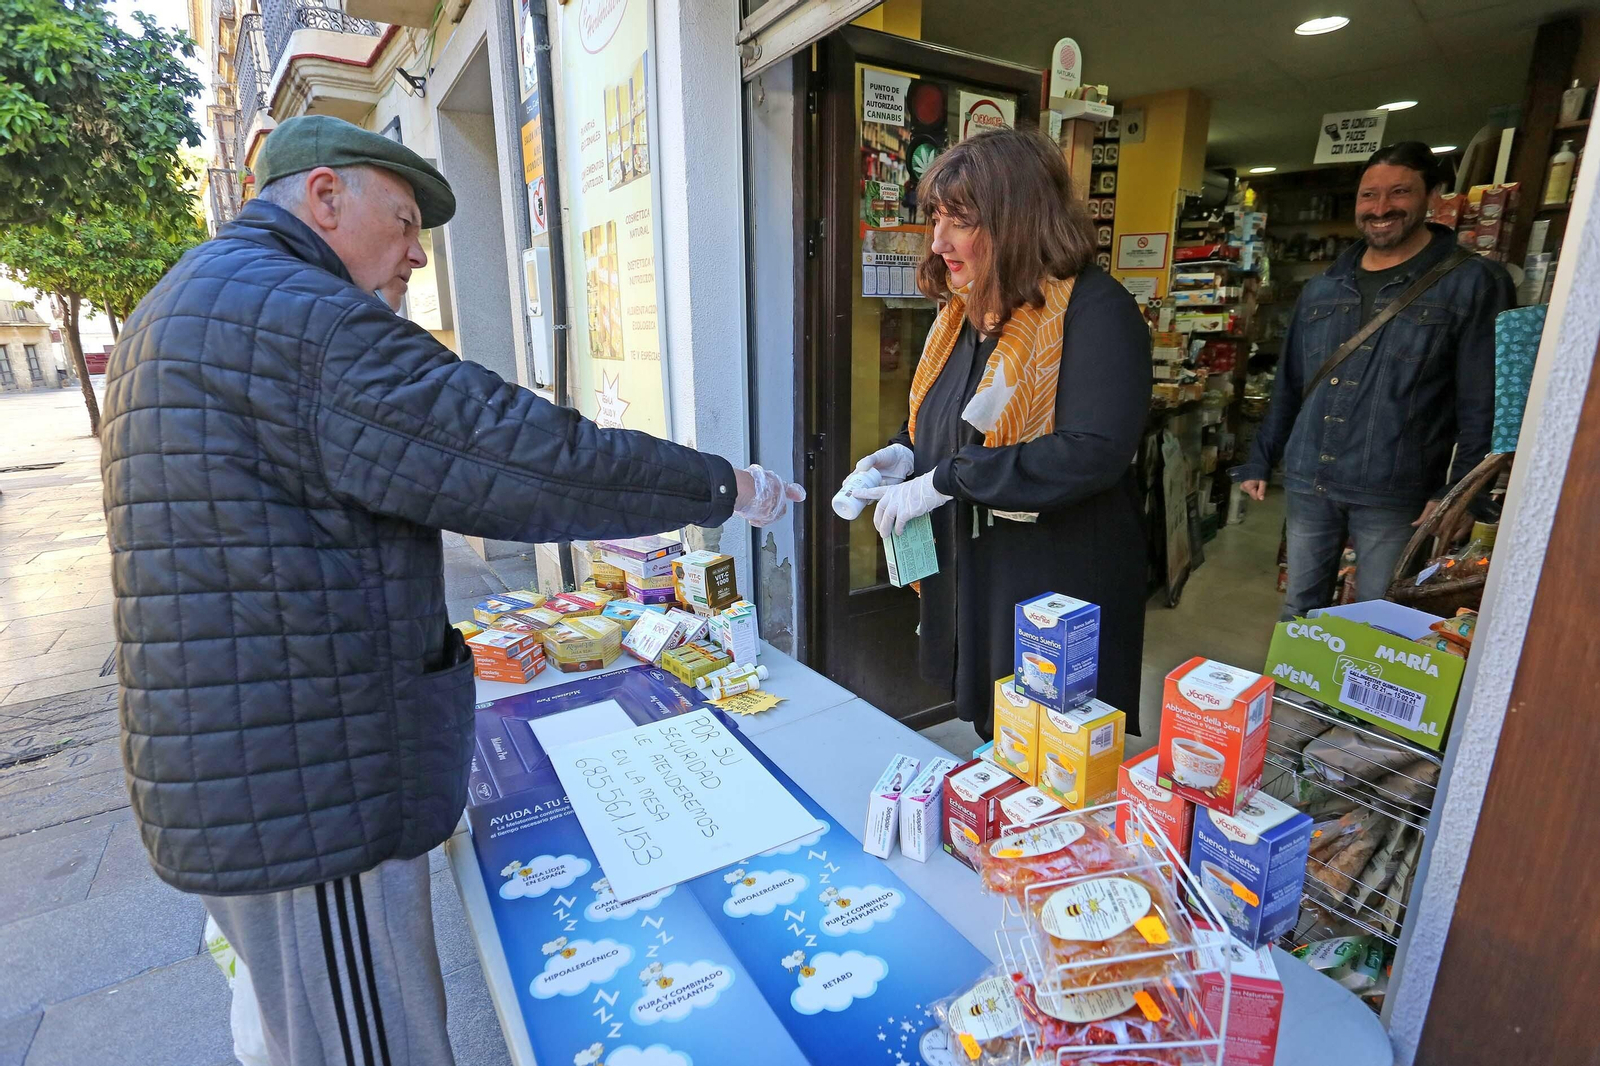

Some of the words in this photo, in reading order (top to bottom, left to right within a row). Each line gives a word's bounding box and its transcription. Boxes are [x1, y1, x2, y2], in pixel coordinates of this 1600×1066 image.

[870, 83, 890, 92] PUNTO
[875, 92, 895, 102] VENTA
[866, 100, 902, 112] AUTORIZADO
[867, 110, 902, 122] CANNABIS
[1341, 119, 1350, 130] SE
[1350, 117, 1379, 129] ADMITEN
[1345, 130, 1366, 141] PAGOS
[1331, 144, 1344, 155] CON
[1345, 142, 1378, 154] TARJETAS
[629, 225, 650, 239] NATURAL
[688, 572, 701, 580] VIT-C
[714, 572, 729, 581] VIT-C
[716, 578, 730, 586] 1000
[1018, 628, 1039, 642] Buenos
[1040, 636, 1062, 650] Sueños
[1286, 623, 1346, 653] CACAO
[1374, 645, 1439, 678] MARÍA
[1272, 663, 1321, 692] AVENA
[1165, 702, 1202, 721] Abbraccio
[1203, 715, 1222, 726] della
[1223, 721, 1240, 734] Sera
[1176, 713, 1199, 726] Rooibos
[685, 715, 721, 744] POR
[711, 747, 743, 766] SU
[658, 726, 722, 790] SEGURIDAD
[611, 749, 632, 766] EN
[624, 770, 646, 785] LA
[638, 788, 670, 822] MESA
[633, 733, 652, 747] LE
[649, 754, 719, 838] ATENDEREMOS
[490, 807, 531, 827] AYUDA
[534, 805, 543, 813] A
[543, 797, 561, 809] TU
[950, 797, 977, 820] Echinacea
[1121, 787, 1147, 808] Buenos
[1148, 801, 1177, 824] Sueños
[497, 828, 520, 837] tiempo
[519, 818, 549, 833] necesario
[549, 814, 564, 823] para
[506, 815, 540, 830] Melatonina
[540, 805, 570, 819] contribuye
[1198, 830, 1229, 855] Buenos
[1228, 849, 1261, 875] Sueños
[538, 870, 566, 883] ESPAÑA
[734, 876, 795, 906] HIPOALERGÉNICO
[595, 899, 619, 911] GAMA
[605, 905, 621, 913] DEL
[825, 914, 846, 927] PURA
[851, 892, 894, 914] COMBINADO
[841, 916, 858, 927] CON
[858, 901, 889, 920] PLANTAS
[544, 949, 619, 984] HIPOALERGÉNICO
[638, 997, 662, 1013] PURA
[668, 970, 724, 998] COMBINADO
[822, 971, 853, 991] RETARD
[655, 1001, 677, 1014] CON
[678, 983, 715, 1004] PLANTAS
